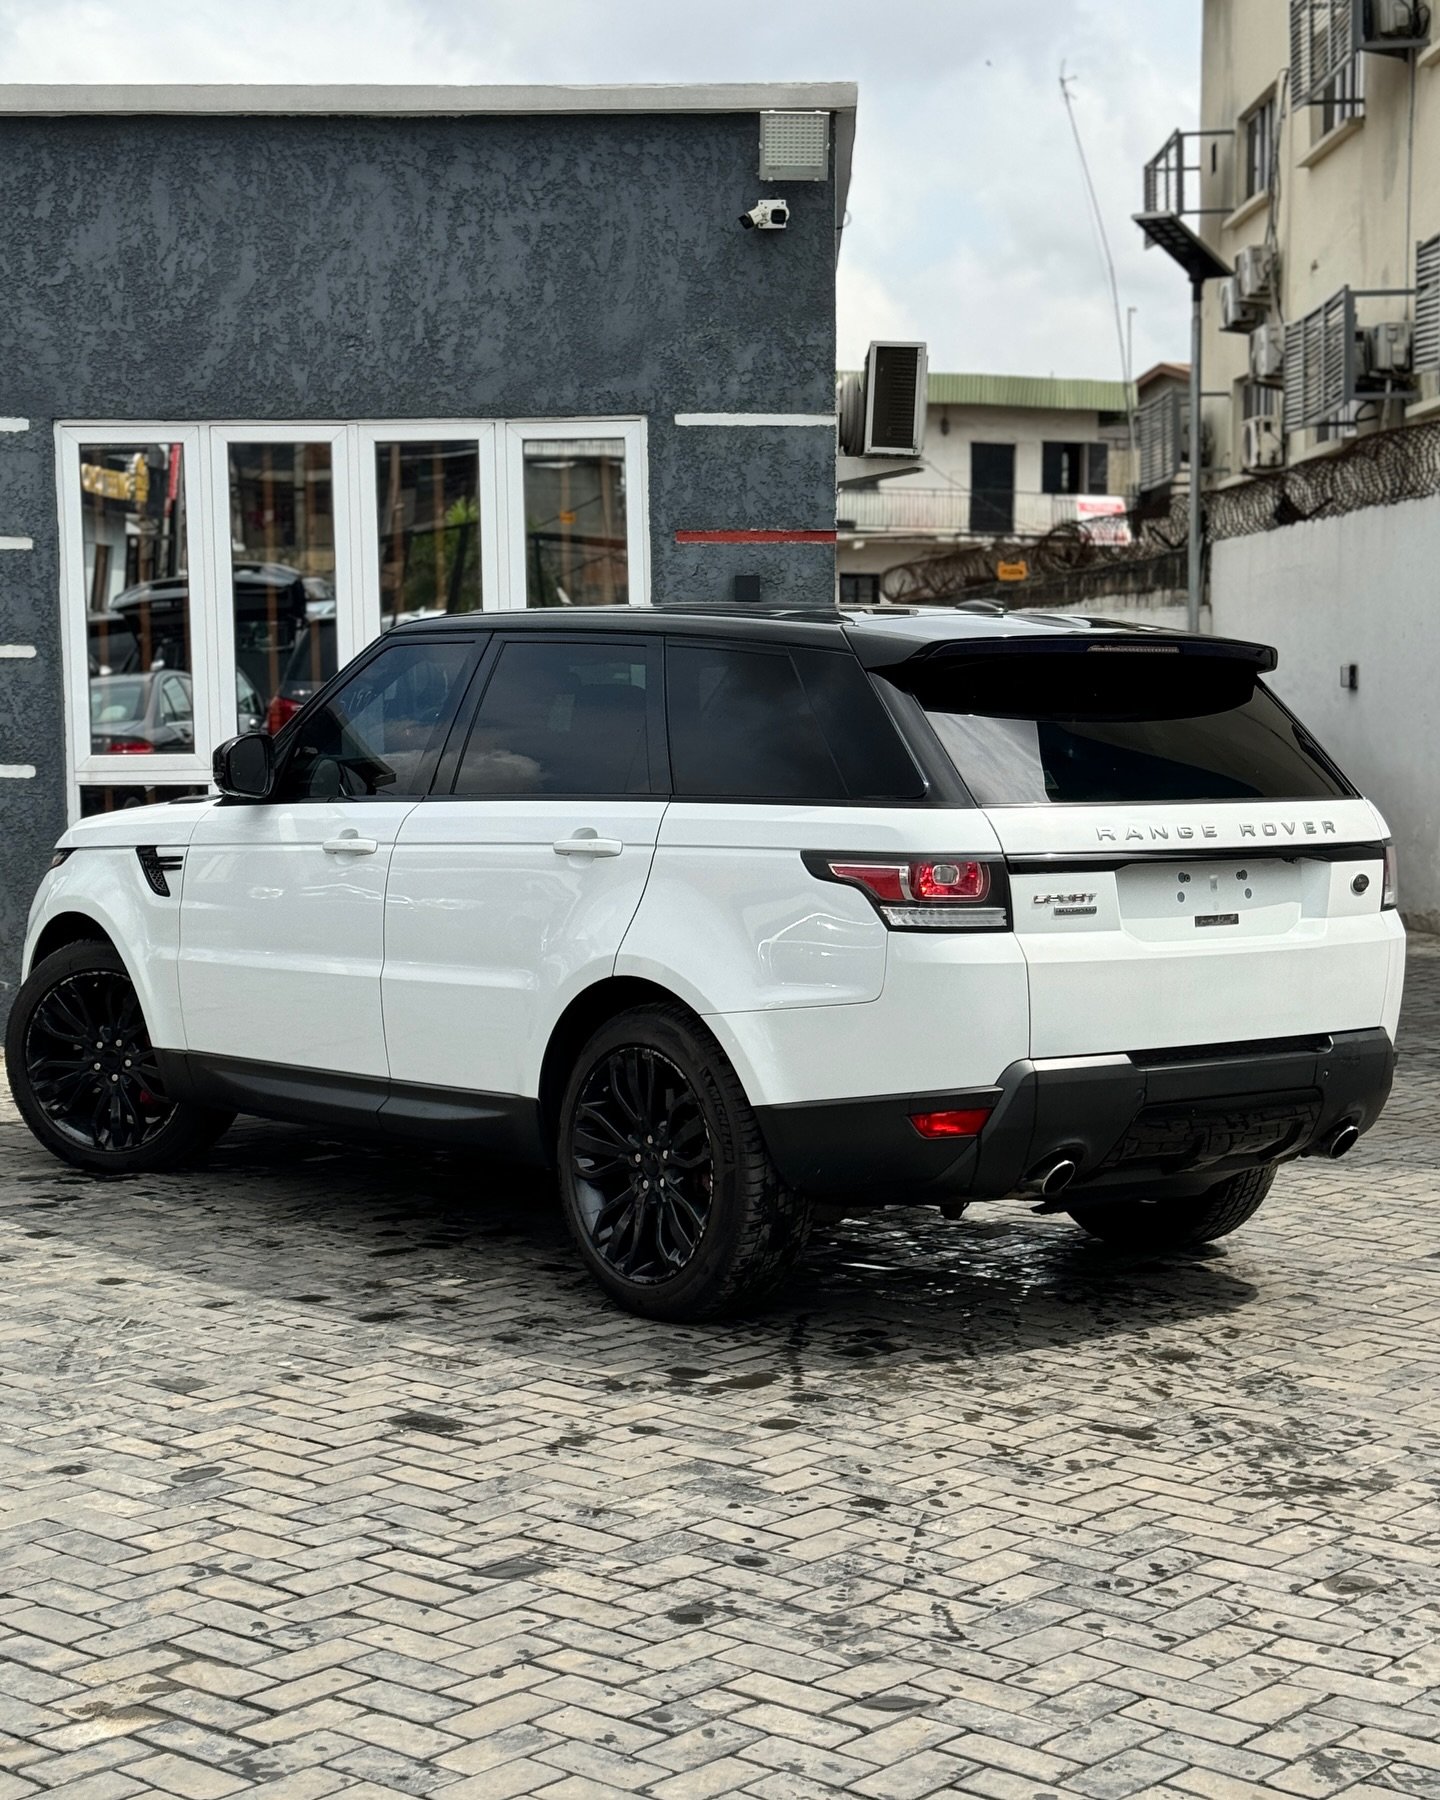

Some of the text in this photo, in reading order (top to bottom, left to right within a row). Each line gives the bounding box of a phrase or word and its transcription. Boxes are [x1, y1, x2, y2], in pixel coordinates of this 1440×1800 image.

[1095, 820, 1336, 841] RANGE ROVER
[1033, 893, 1096, 904] SPORT
